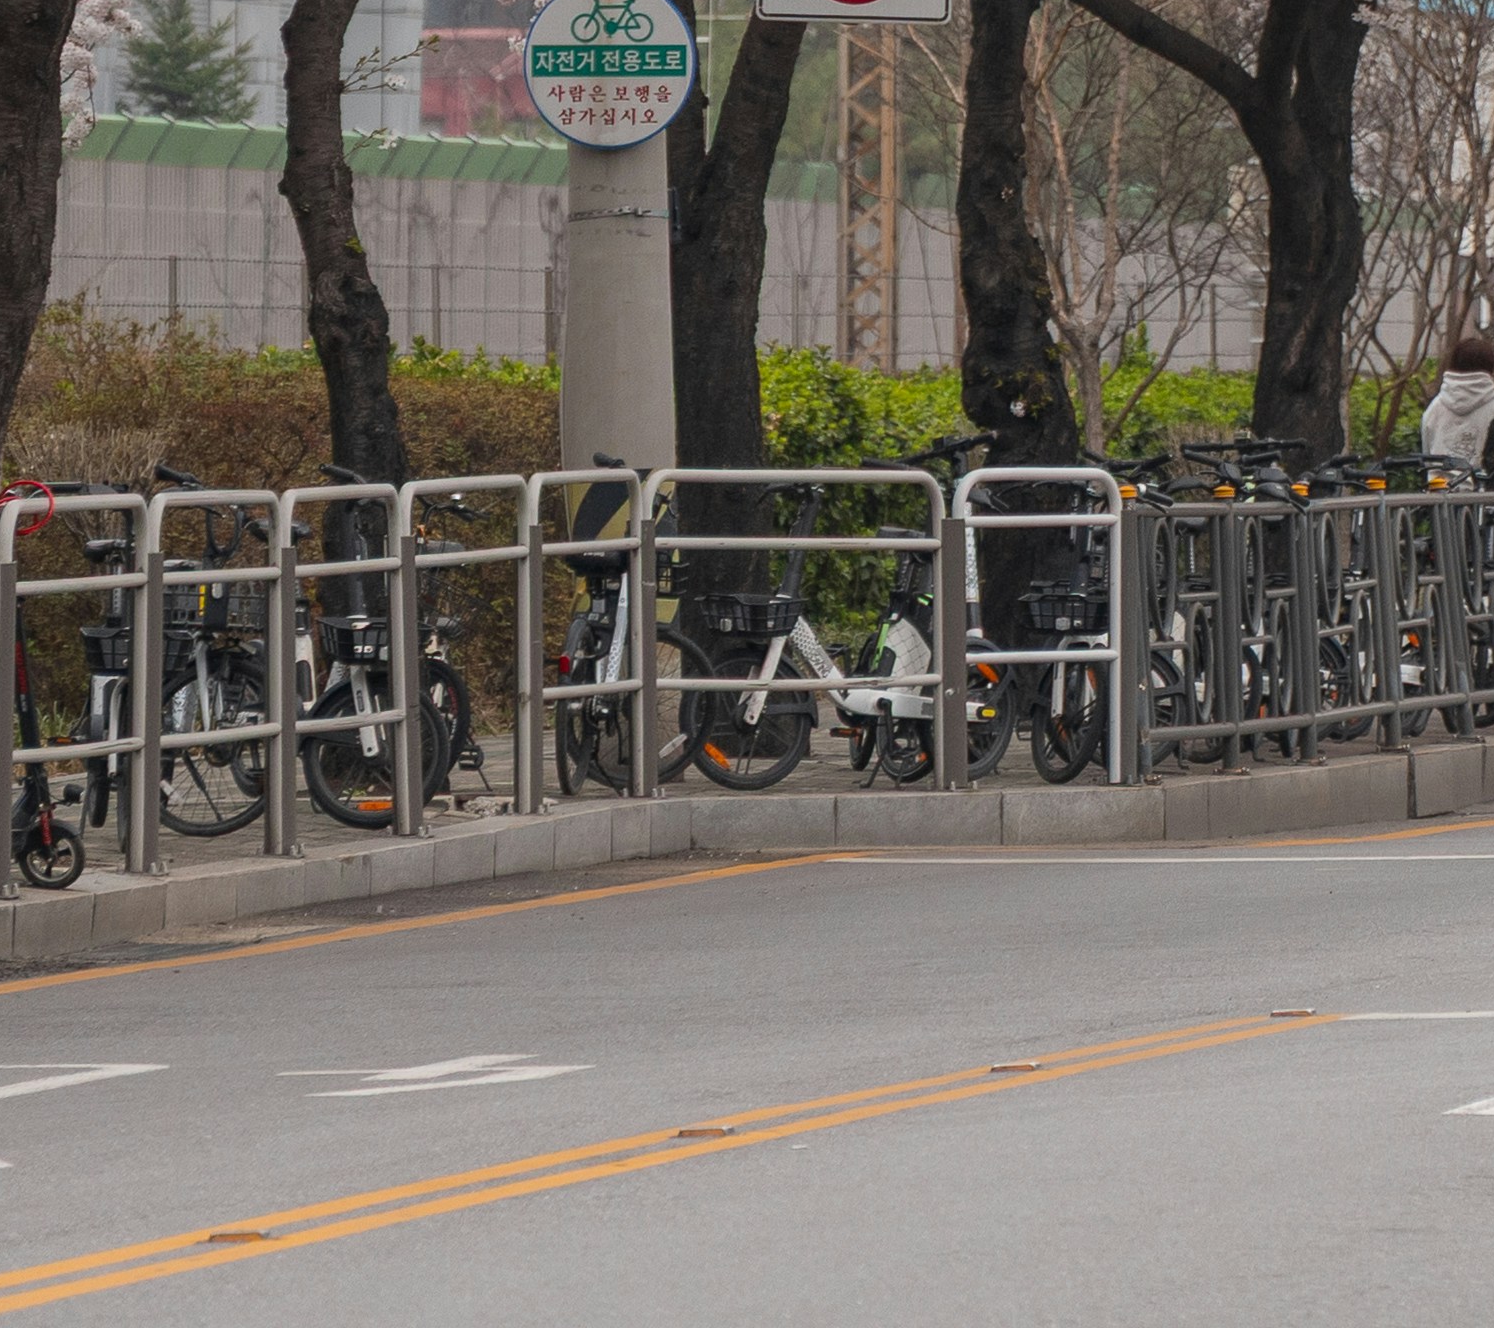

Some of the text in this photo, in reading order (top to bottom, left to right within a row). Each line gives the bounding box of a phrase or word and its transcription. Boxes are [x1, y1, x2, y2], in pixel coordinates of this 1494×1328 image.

[535, 49, 684, 73] 자전거 전용도로
[548, 85, 672, 103] 사람은 보행을
[558, 108, 658, 126] 삼가십시오
